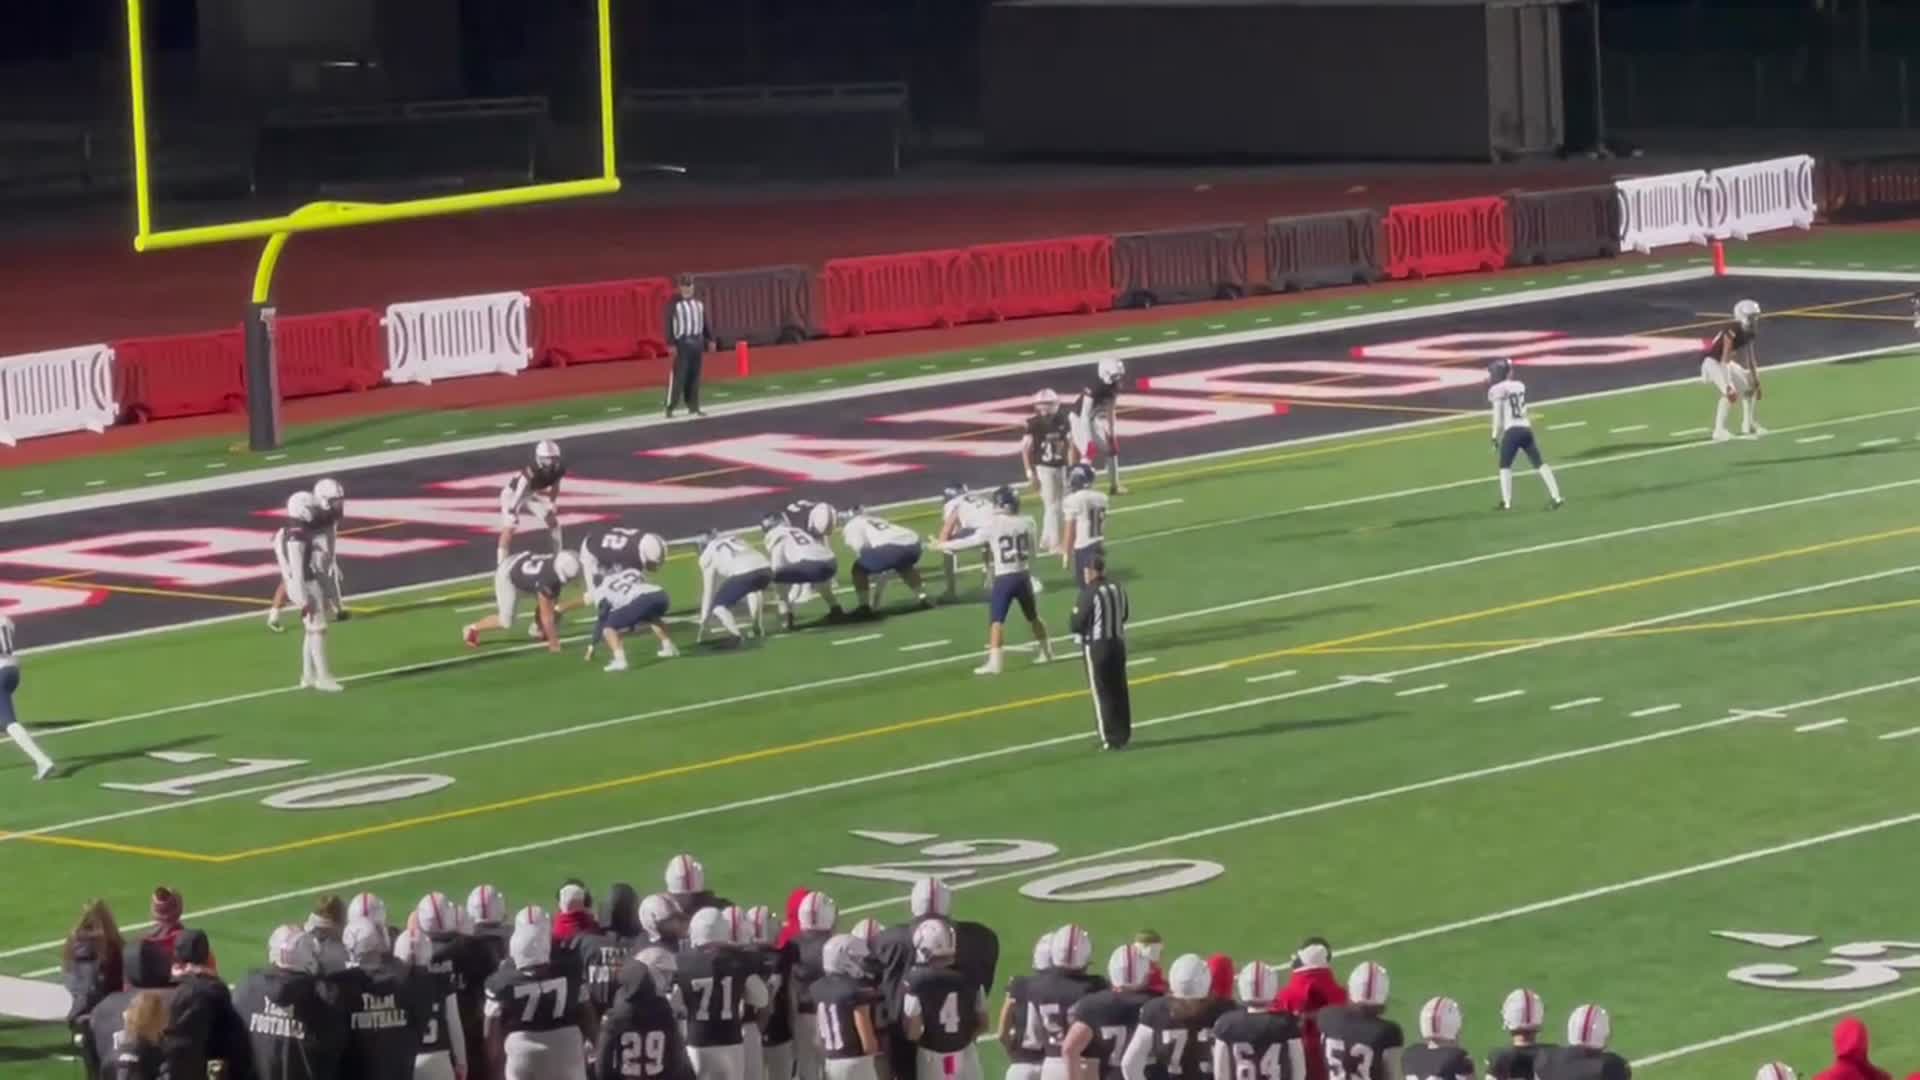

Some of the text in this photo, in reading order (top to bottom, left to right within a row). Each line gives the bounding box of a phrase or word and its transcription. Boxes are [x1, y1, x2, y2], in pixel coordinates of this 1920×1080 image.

[100, 759, 456, 809] 10
[816, 838, 1225, 901] 20
[351, 1009, 408, 1030] FOOTBALL
[513, 977, 567, 1022] 77
[691, 976, 733, 1021] 71
[939, 991, 961, 1033] 4
[620, 1030, 666, 1077] 29
[1232, 1042, 1282, 1080] 64
[1325, 1037, 1374, 1080] 53
